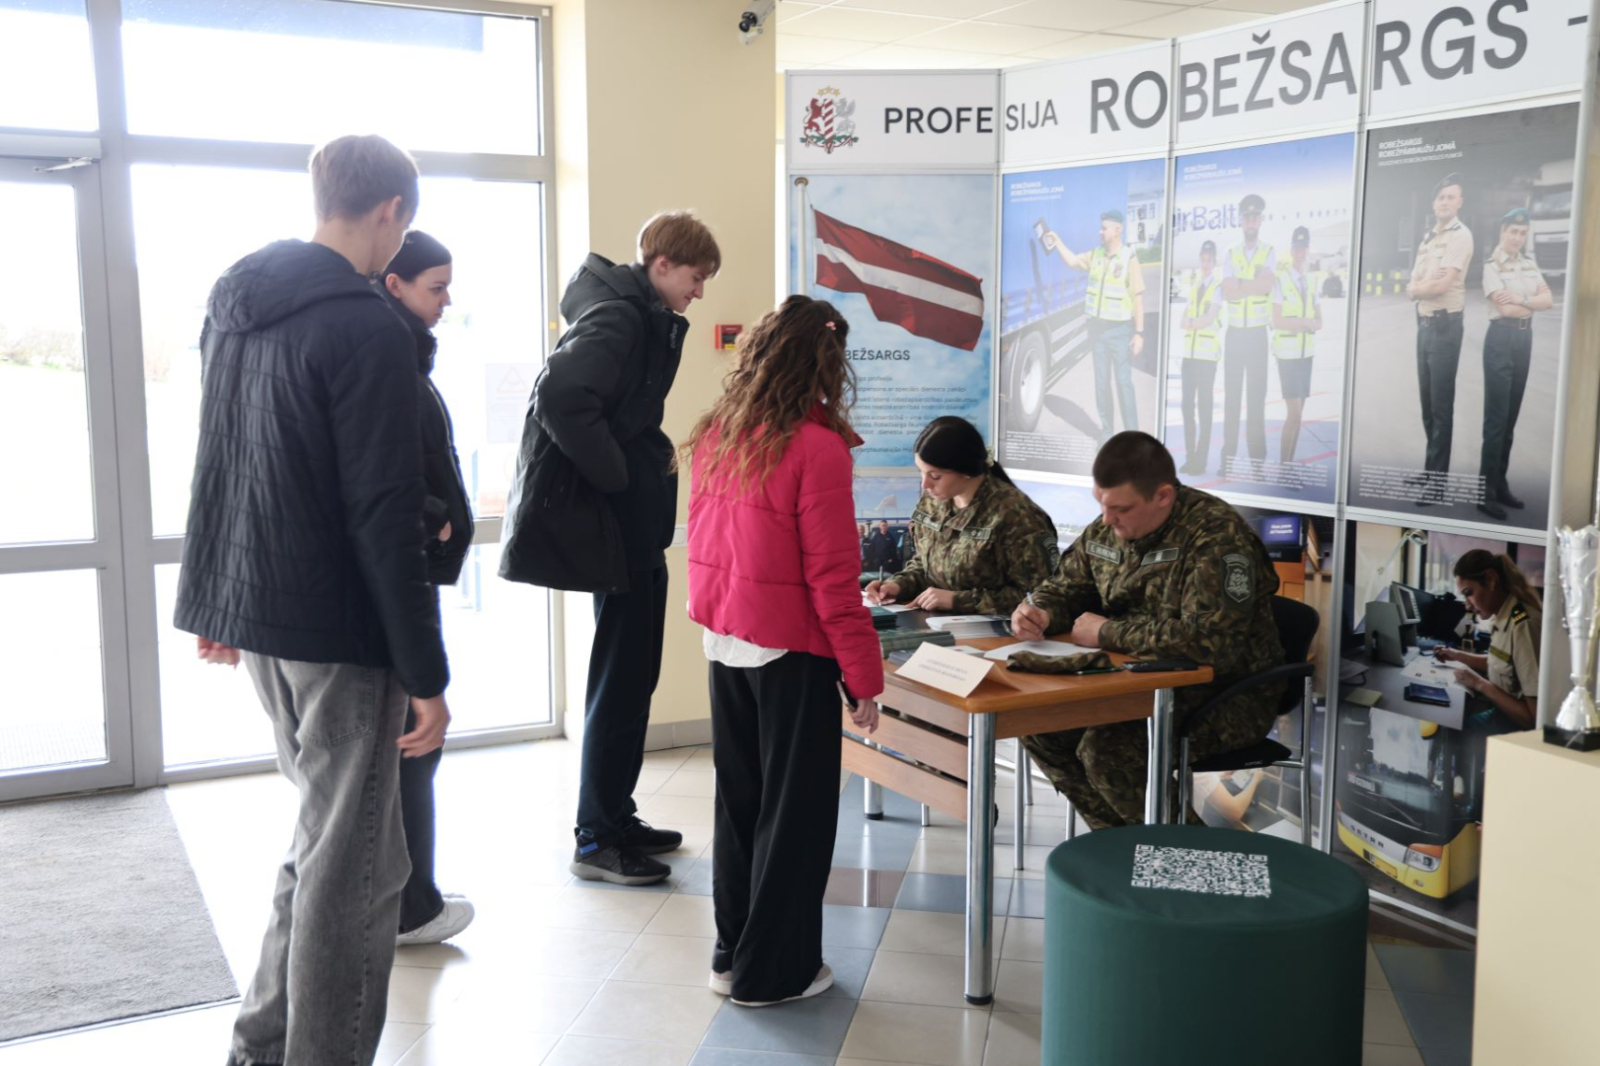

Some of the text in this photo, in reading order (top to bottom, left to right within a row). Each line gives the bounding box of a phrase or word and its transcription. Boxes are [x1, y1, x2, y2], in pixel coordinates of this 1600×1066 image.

[884, 99, 1058, 134] PROFESIJA
[1090, 0, 1528, 135] ROBEŽSARGS
[845, 348, 910, 361] BEŽSARGS
